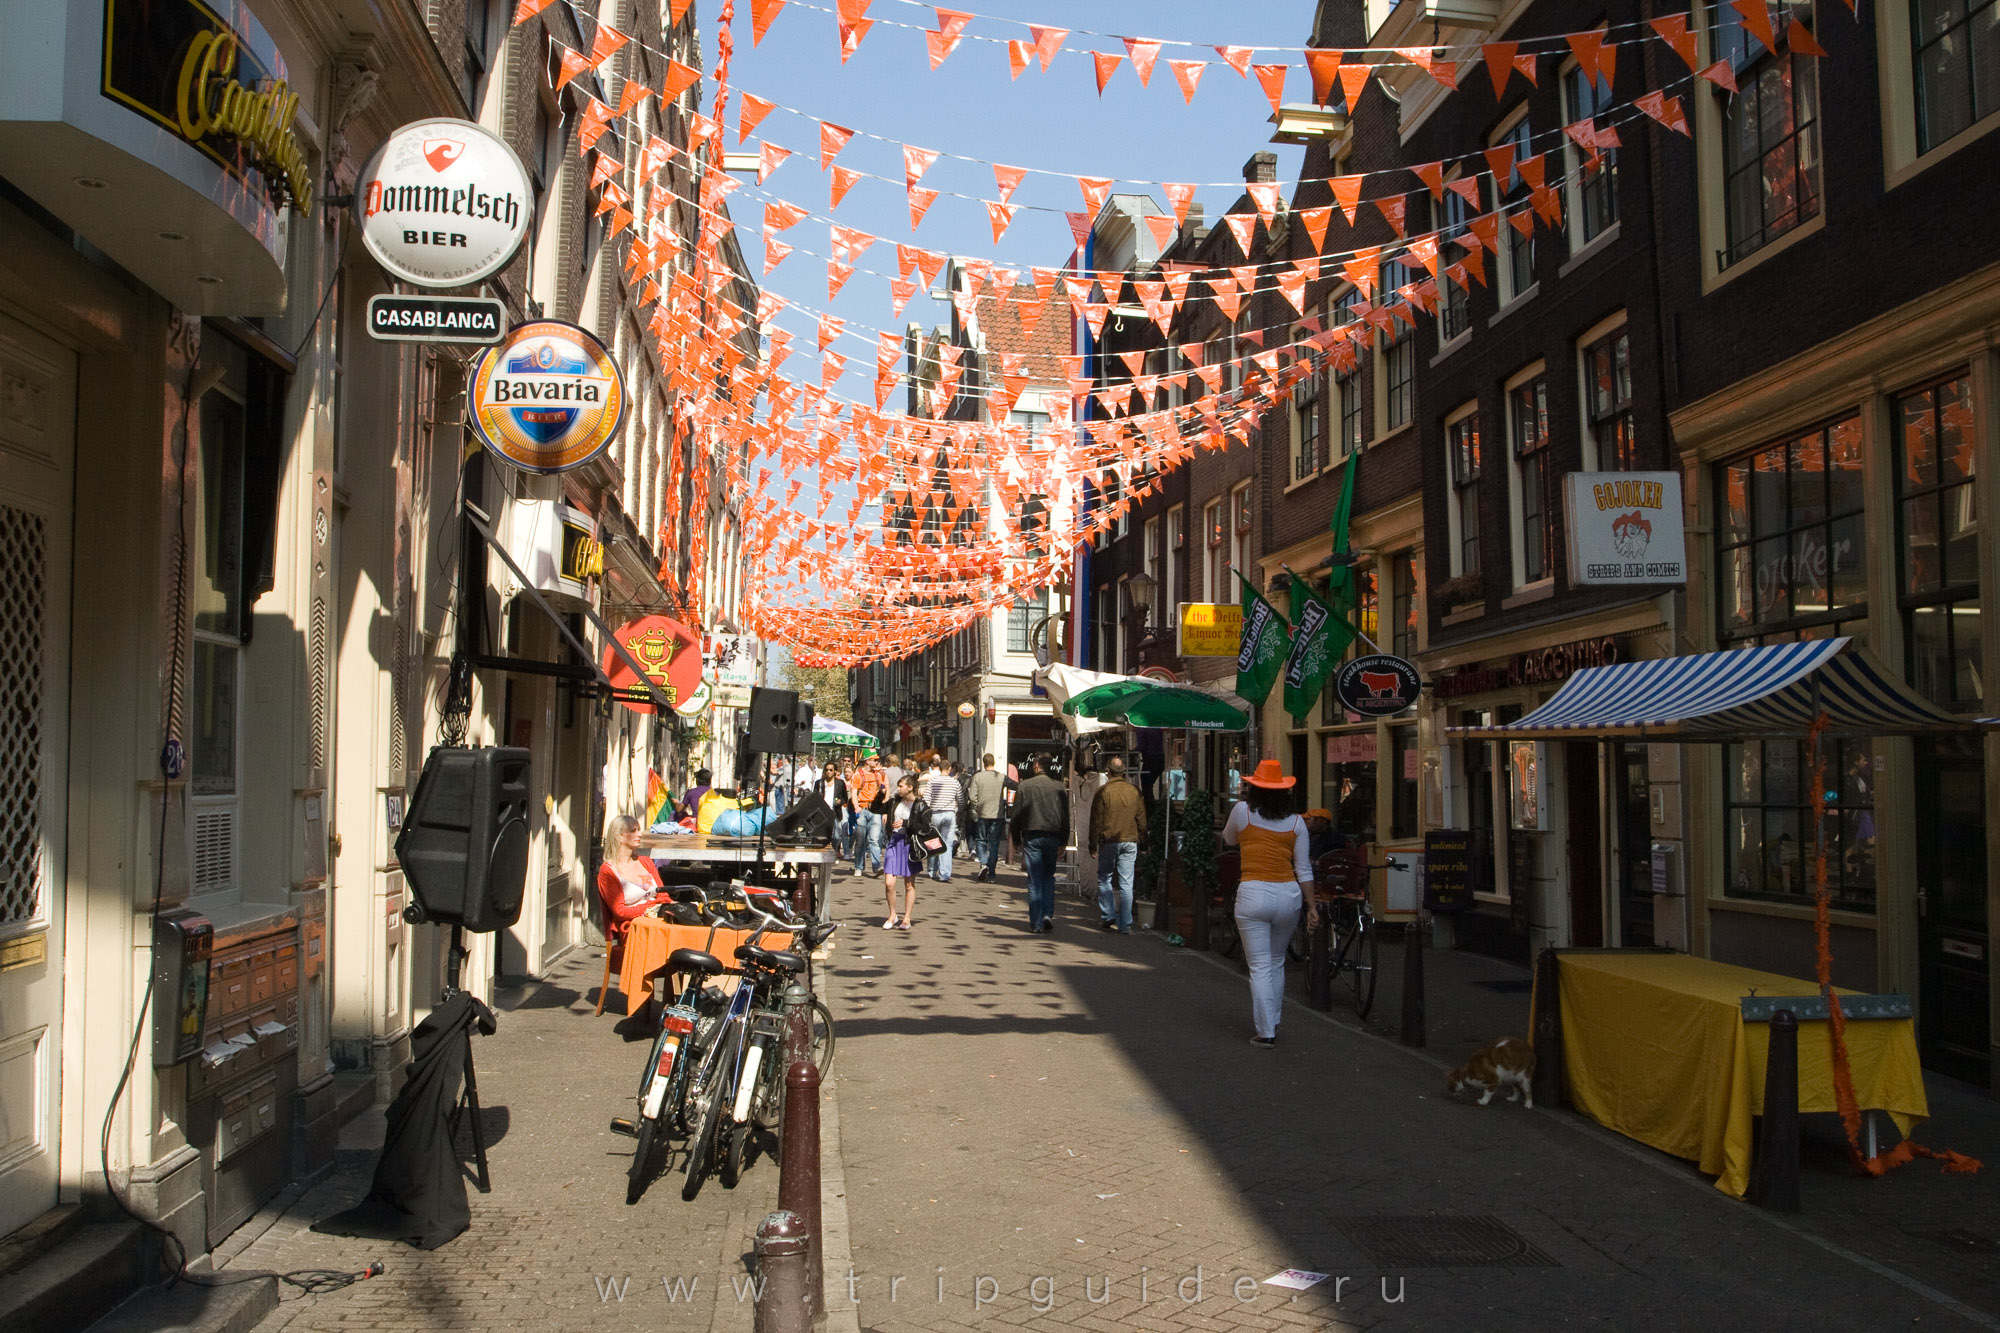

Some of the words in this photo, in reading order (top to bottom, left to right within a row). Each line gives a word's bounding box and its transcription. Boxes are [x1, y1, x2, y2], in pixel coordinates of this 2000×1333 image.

[365, 180, 519, 231] Dommelsch
[403, 230, 467, 247] BIER
[375, 240, 435, 279] PREMIUM
[443, 248, 502, 279] QUALITY
[376, 309, 496, 329] CASABLANCA
[494, 379, 599, 402] Bavaria
[528, 413, 562, 421] BIER
[1593, 480, 1663, 511] GOJOKER
[1588, 564, 1621, 578] STRIPS
[1624, 563, 1644, 577] AND
[1646, 563, 1680, 576] COMICS
[1192, 612, 1207, 623] the
[1188, 625, 1222, 640] Liquor
[706, 671, 747, 682] mrita-ya
[1343, 659, 1379, 687] steakhouse
[1380, 659, 1416, 685] restaurant
